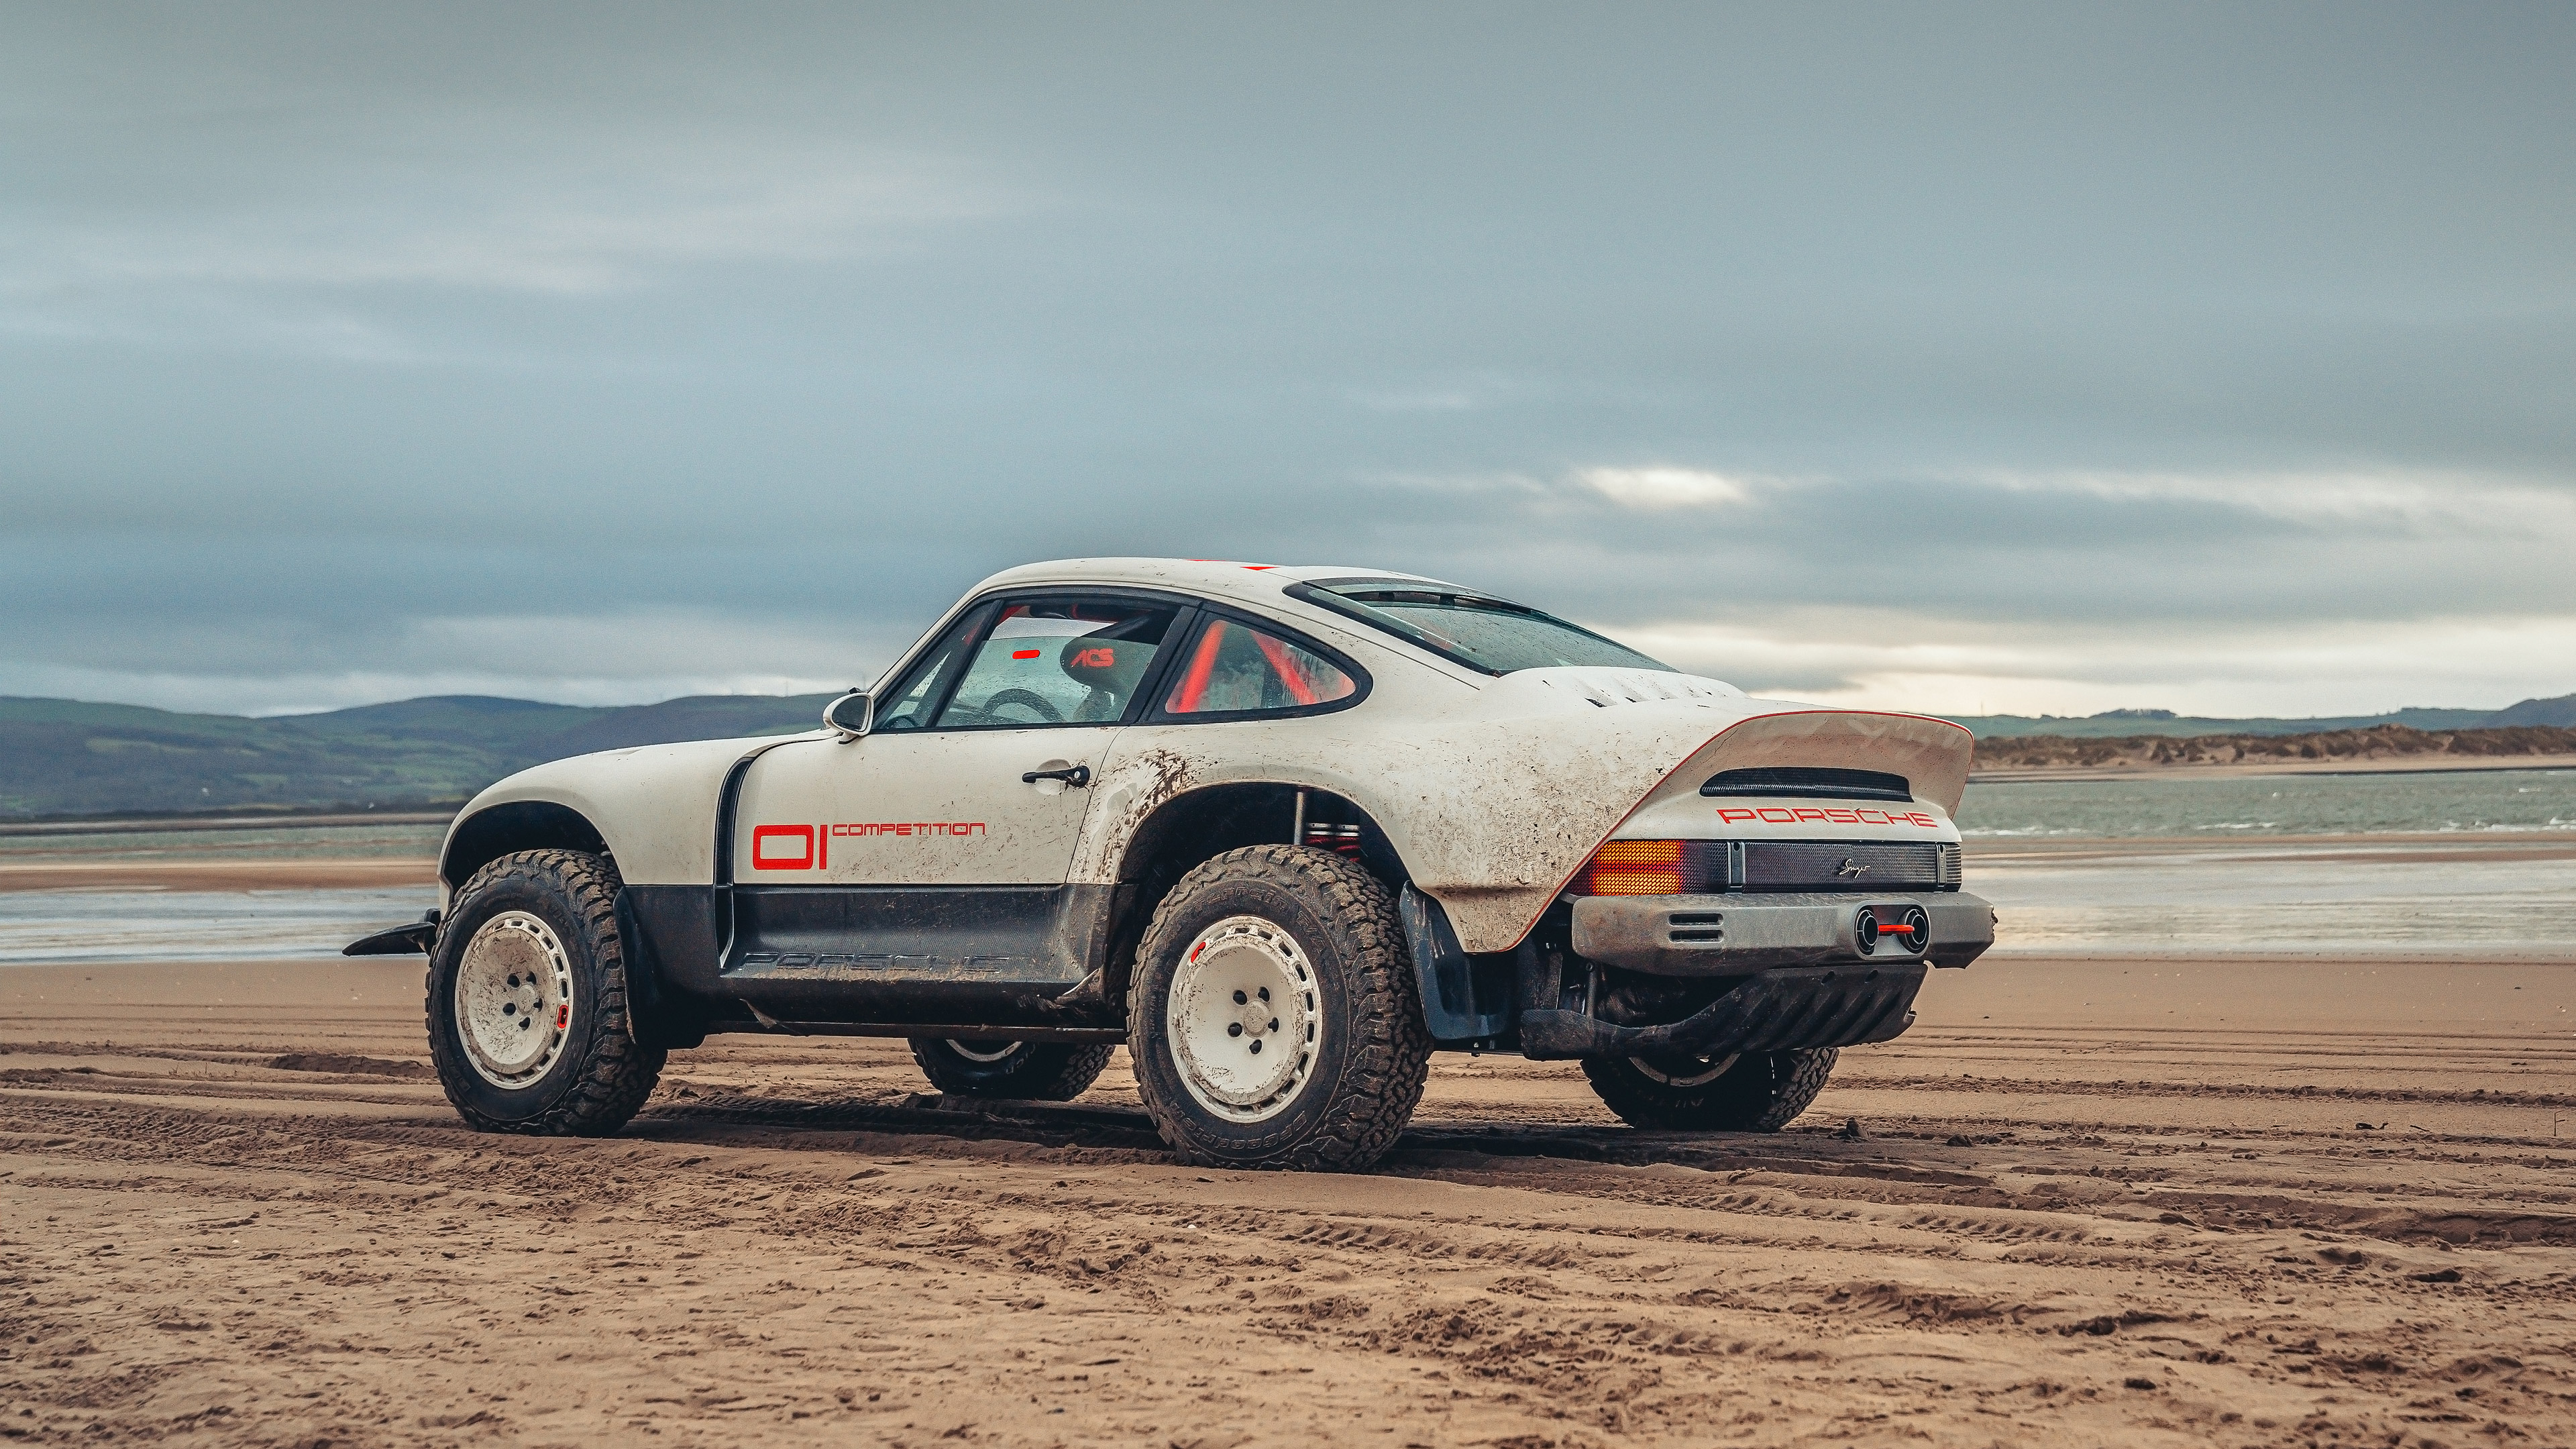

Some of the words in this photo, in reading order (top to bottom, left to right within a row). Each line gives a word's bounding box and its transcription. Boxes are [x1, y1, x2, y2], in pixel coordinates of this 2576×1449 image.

[1071, 648, 1114, 667] ACS
[1716, 808, 1938, 827] PORSCHE
[832, 822, 986, 836] COMPETITION
[1839, 858, 1870, 879] Singer
